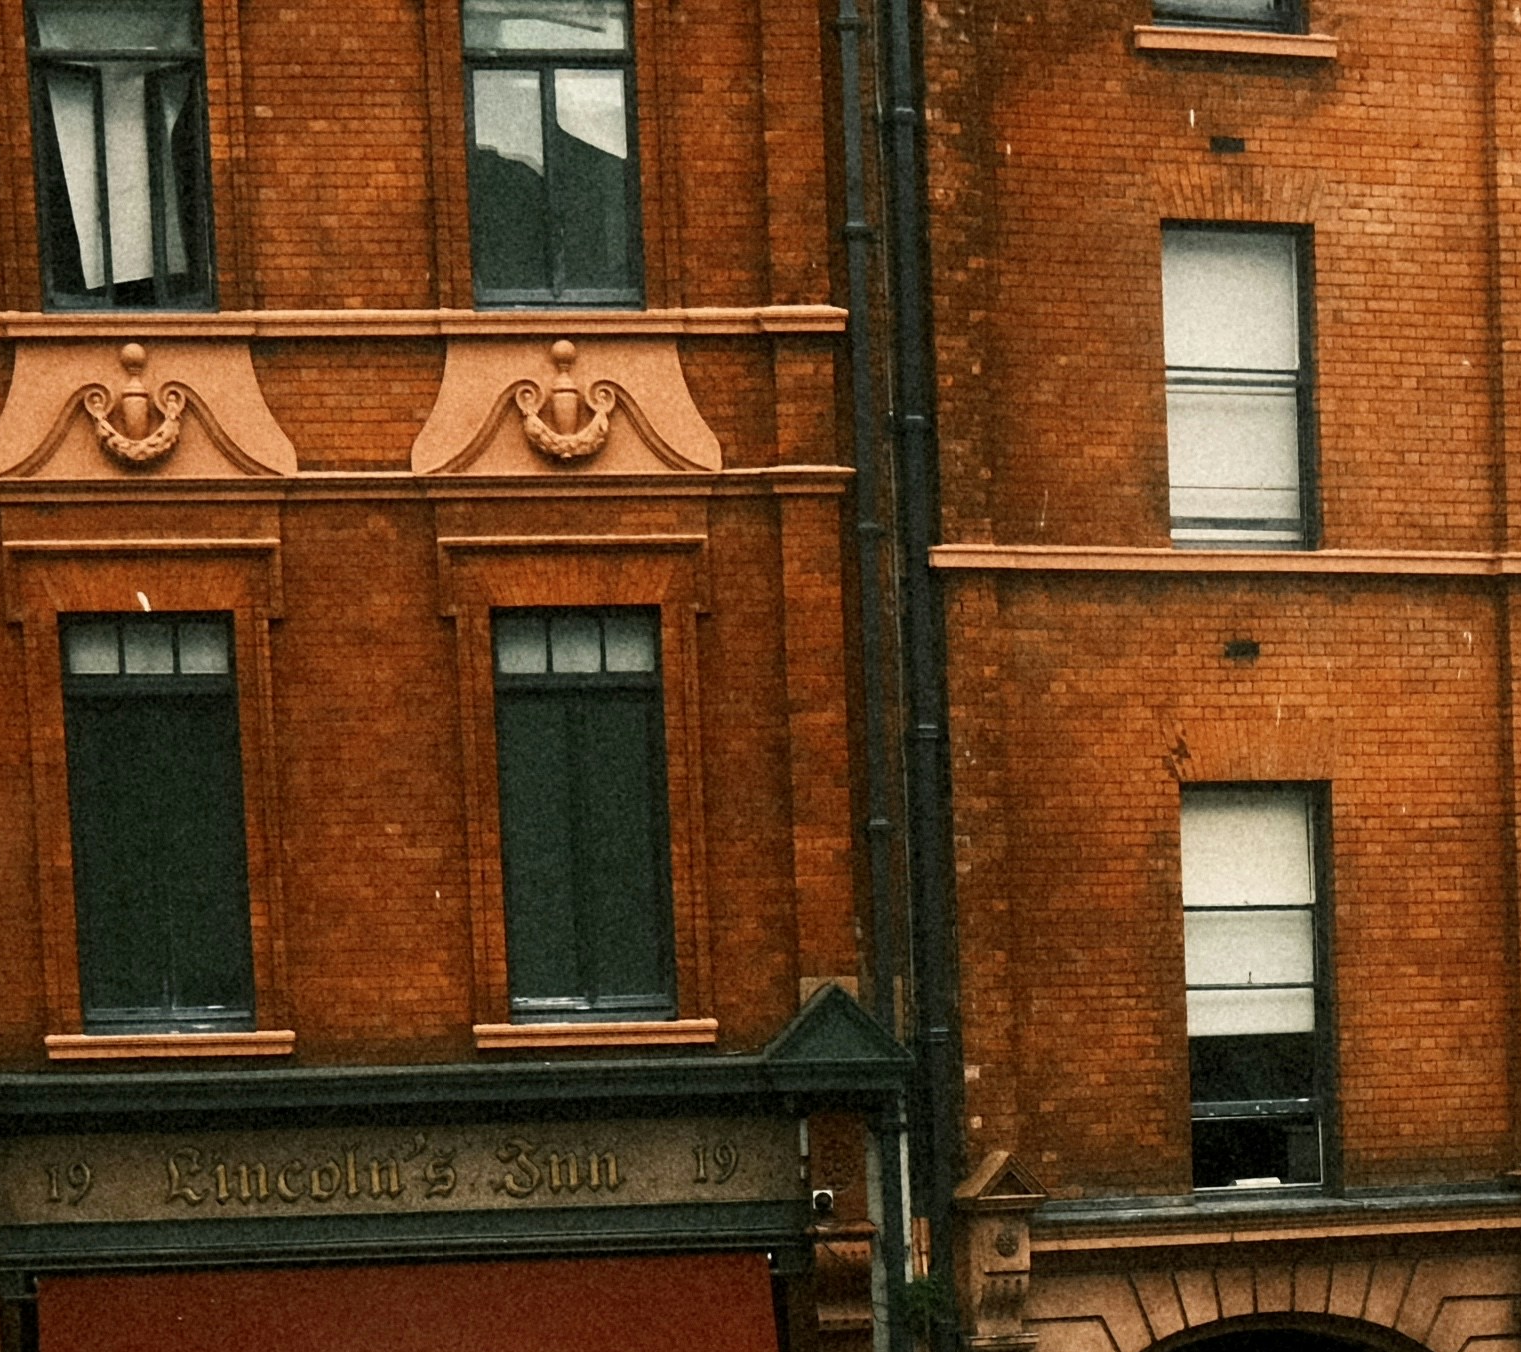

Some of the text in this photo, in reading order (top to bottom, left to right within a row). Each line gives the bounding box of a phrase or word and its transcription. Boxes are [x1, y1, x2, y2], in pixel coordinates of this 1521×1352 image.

[44, 1133, 739, 1208] 19 Lincoln's Inn 19
